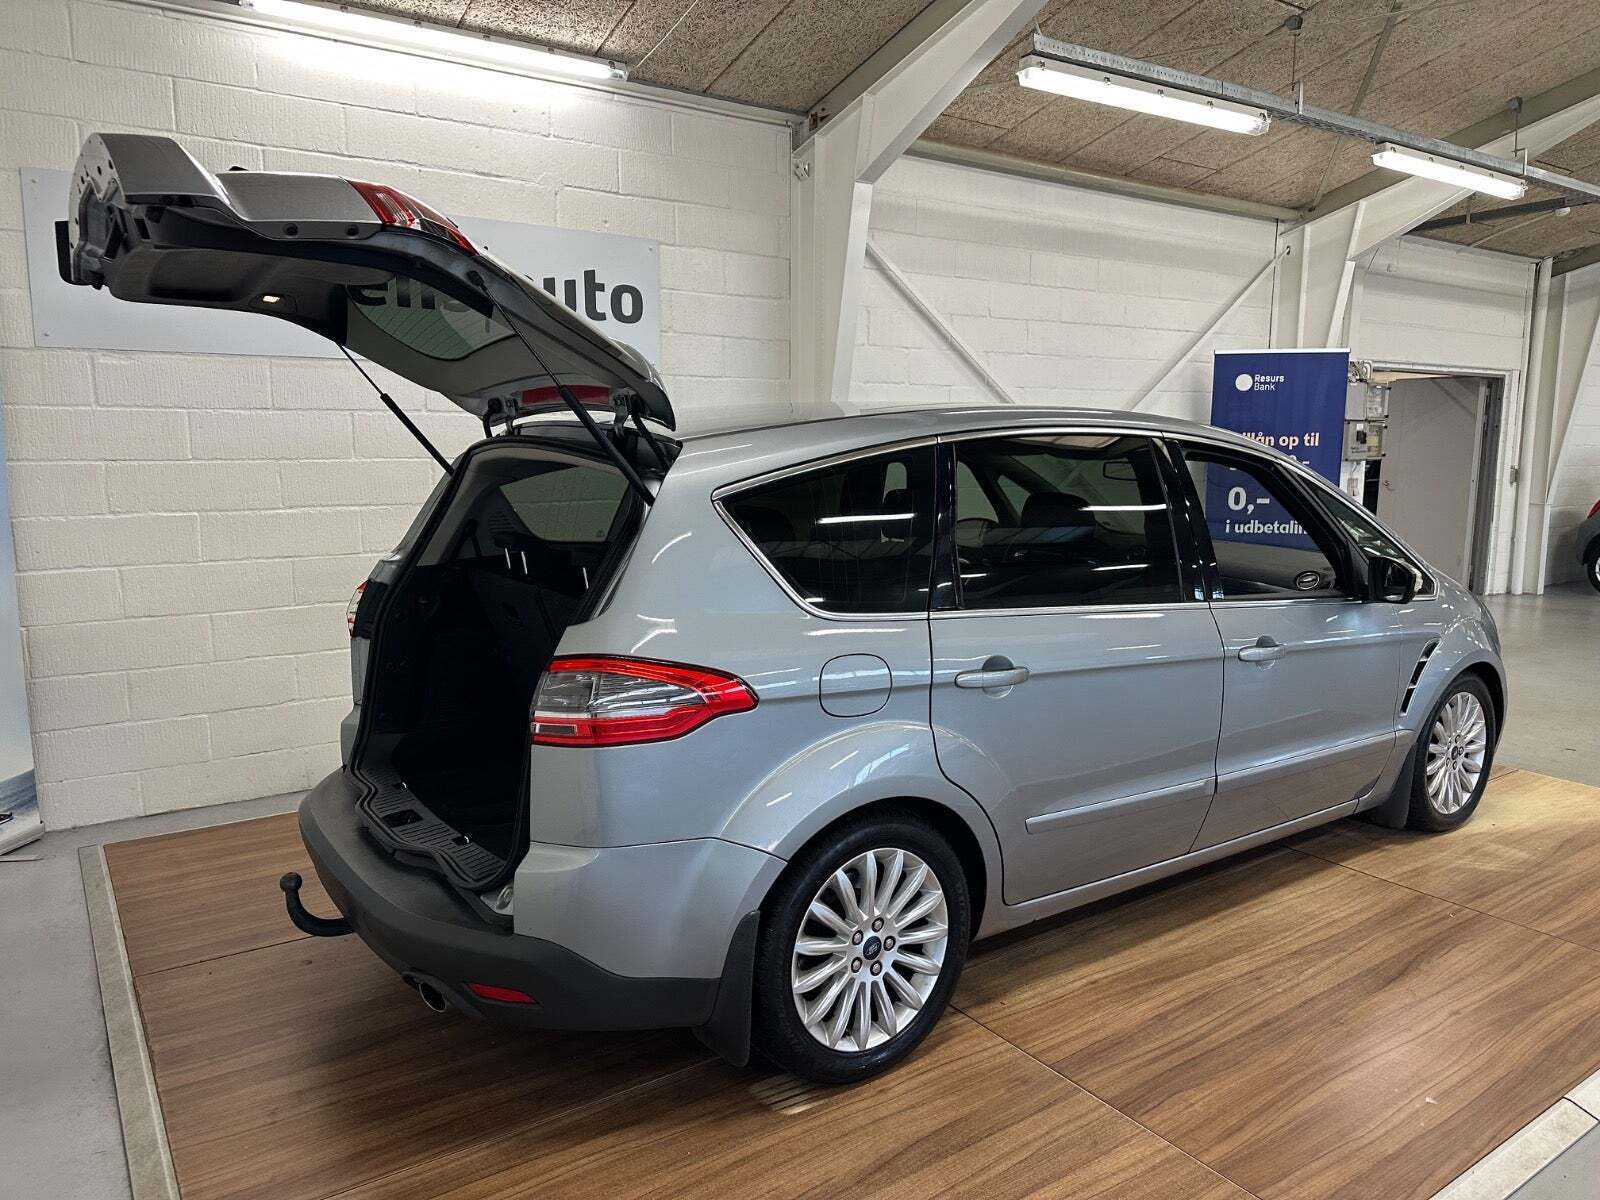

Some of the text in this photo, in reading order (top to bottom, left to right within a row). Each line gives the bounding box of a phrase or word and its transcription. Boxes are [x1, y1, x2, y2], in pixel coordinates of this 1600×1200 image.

[1254, 374, 1285, 383] Resurs
[1254, 383, 1276, 391] Bank
[1279, 435, 1299, 450] op
[1303, 432, 1320, 447] til
[1225, 519, 1230, 534] i
